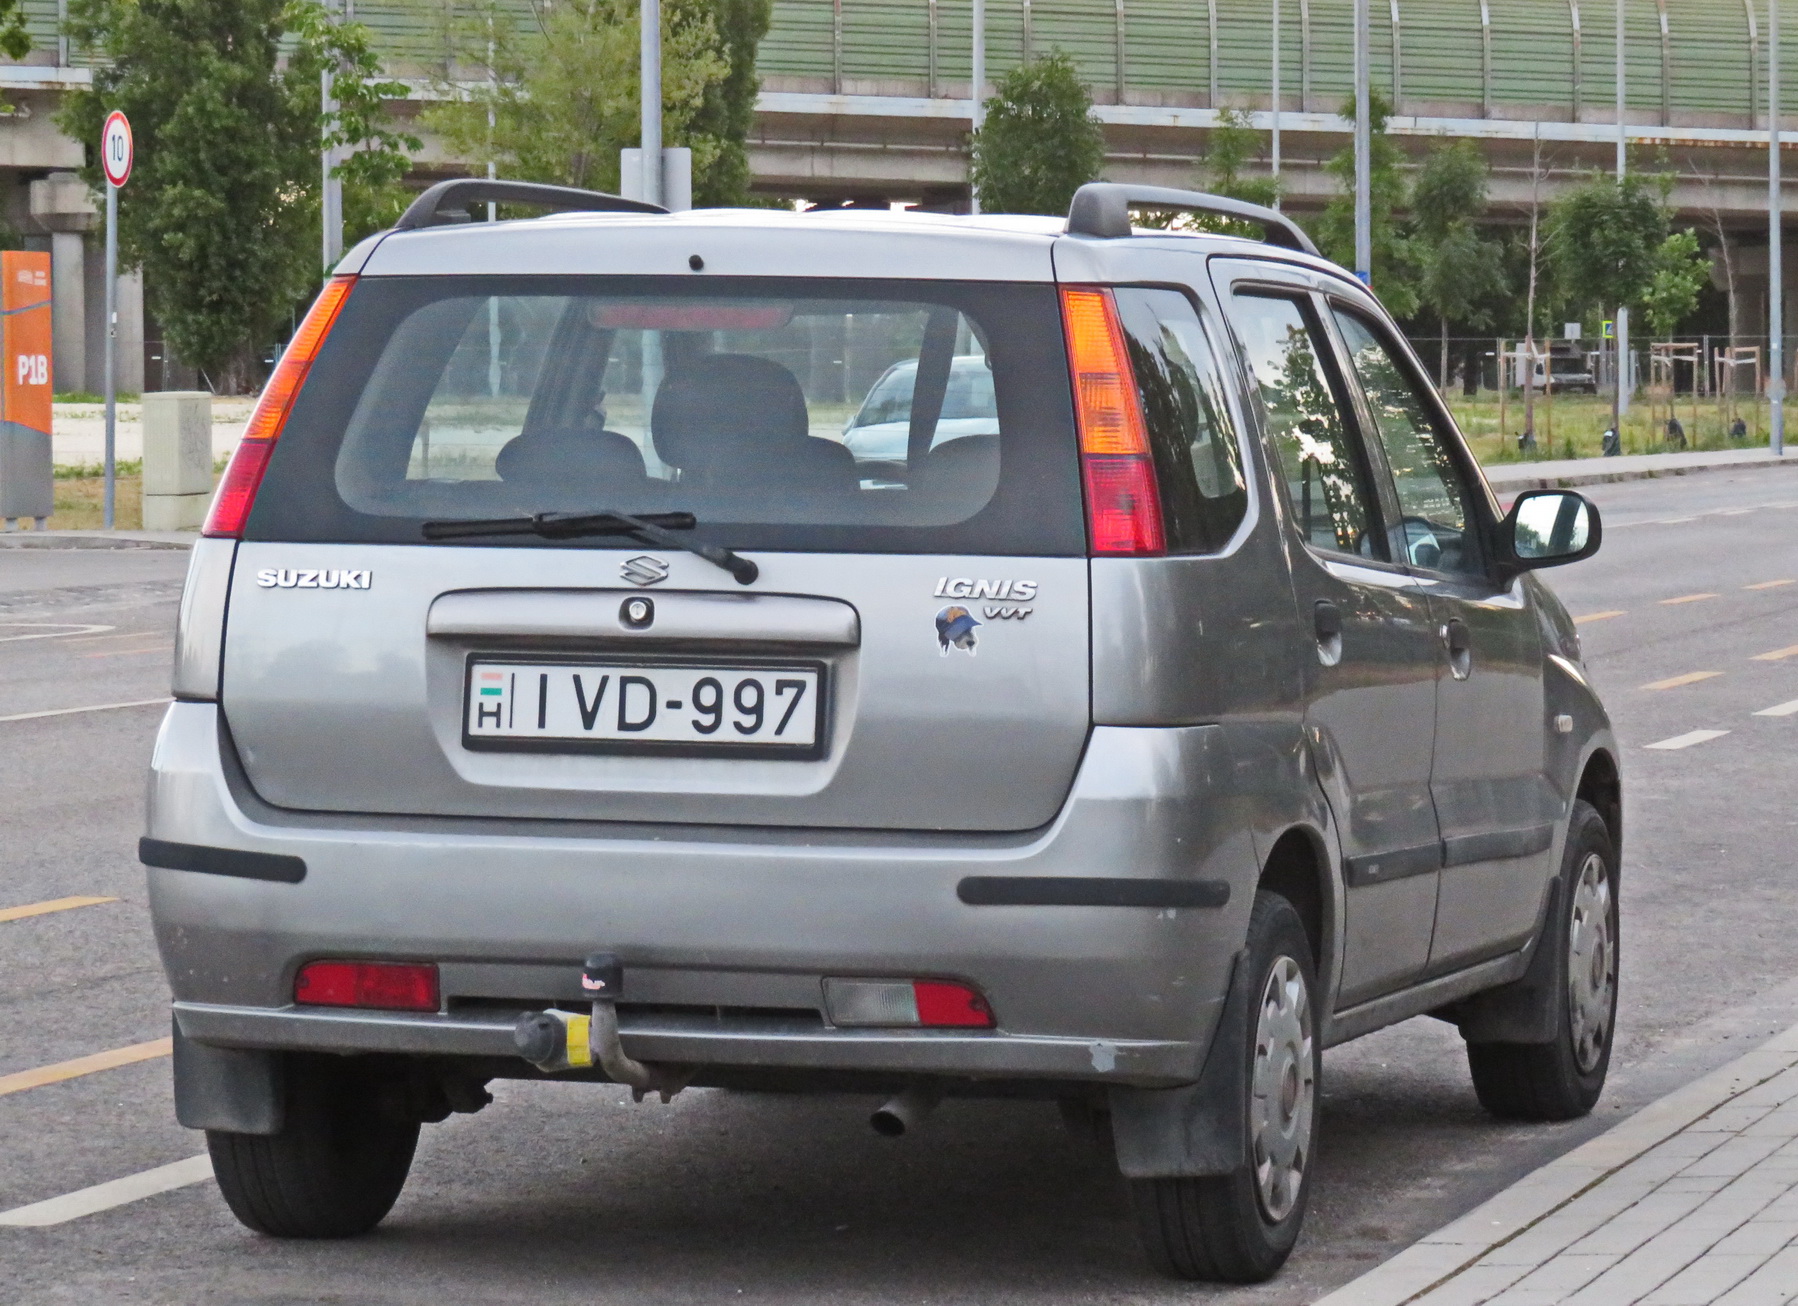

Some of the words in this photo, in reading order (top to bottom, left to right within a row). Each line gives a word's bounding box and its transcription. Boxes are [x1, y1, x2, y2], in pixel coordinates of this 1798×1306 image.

[112, 134, 124, 161] 10
[18, 354, 48, 385] P1B
[256, 568, 373, 590] SUZUKI
[933, 576, 1038, 601] IGNIS
[983, 606, 1033, 620] VVT
[477, 702, 502, 729] H
[537, 673, 807, 736] IVD-997
